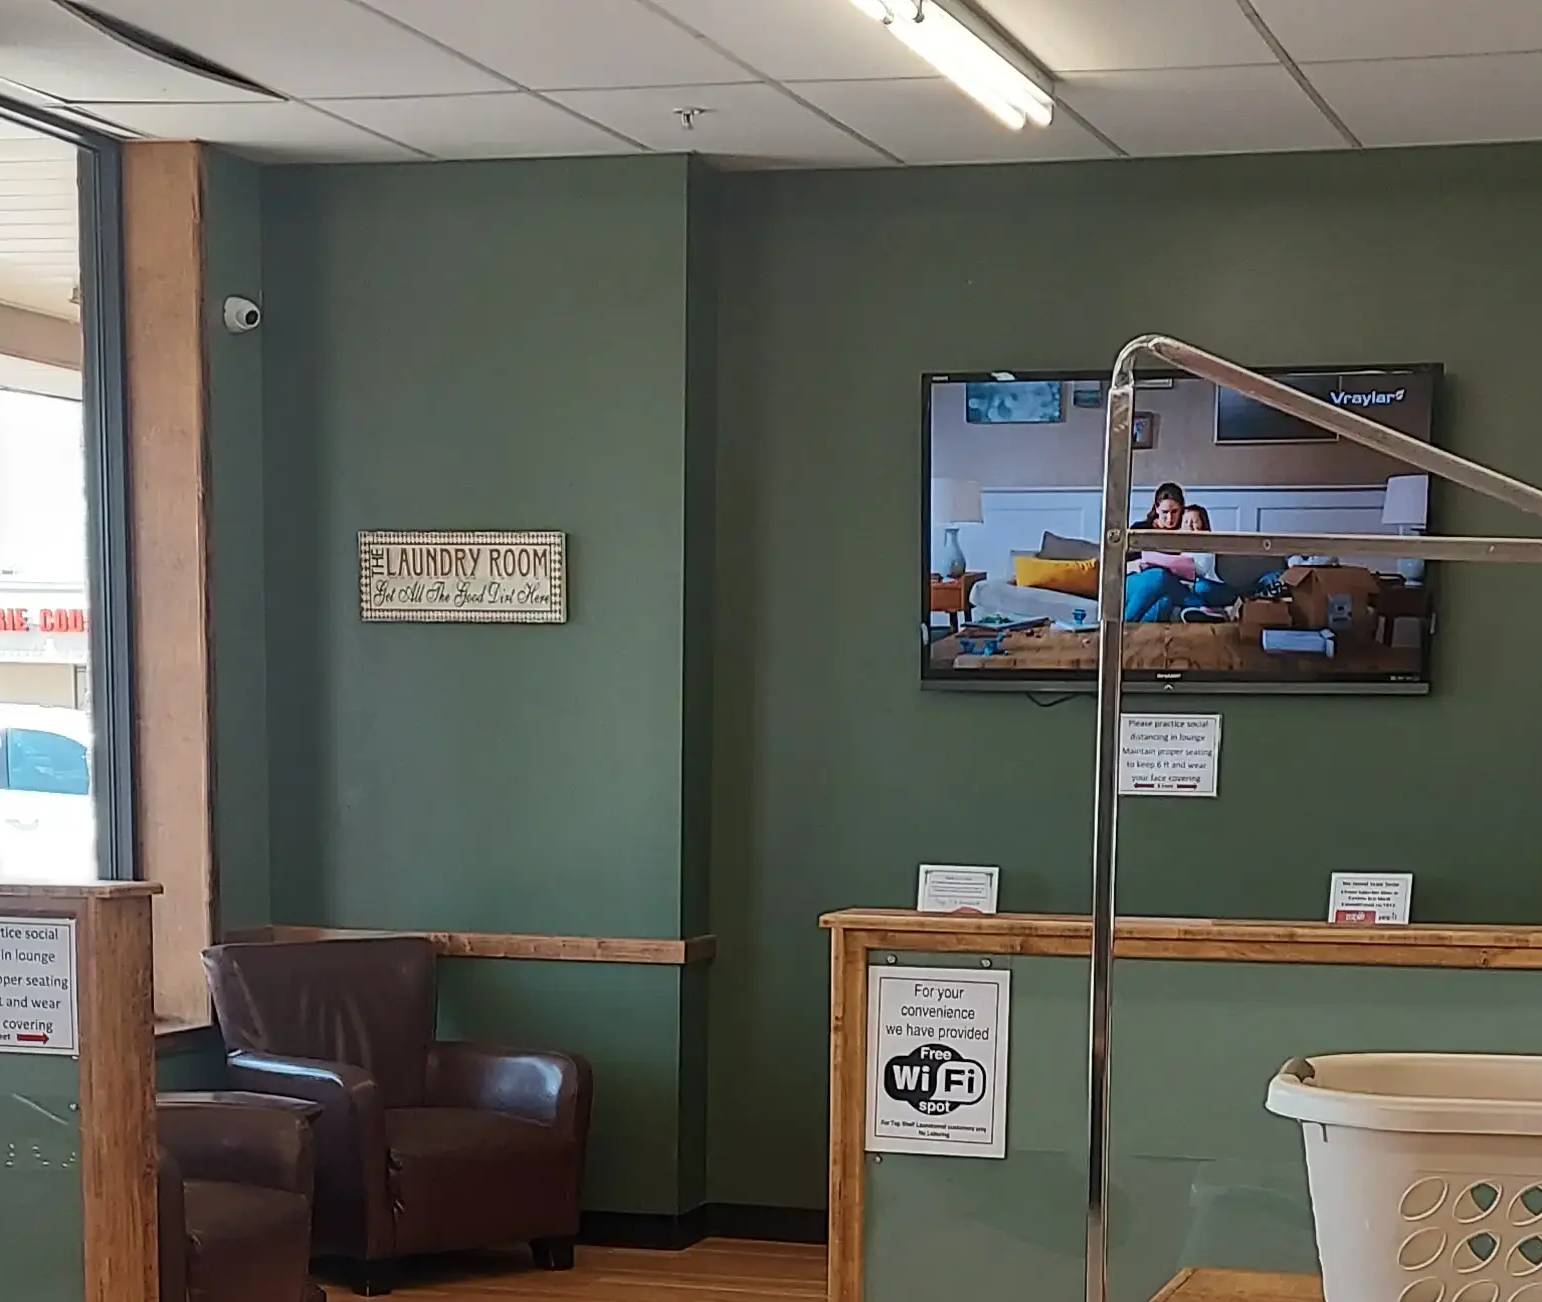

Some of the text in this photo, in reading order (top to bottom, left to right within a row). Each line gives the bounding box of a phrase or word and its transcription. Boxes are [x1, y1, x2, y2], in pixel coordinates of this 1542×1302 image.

[1330, 391, 1396, 407] Vraylar
[371, 547, 548, 577] THE LAUNDRY ROOM
[373, 579, 549, 608] Get All The Good Dirt Here
[1154, 720, 1185, 728] practice
[1187, 720, 1208, 728] social
[1130, 733, 1169, 742] distancing
[1179, 733, 1206, 742] lounge
[1137, 761, 1155, 769] keep
[1172, 761, 1186, 769] and
[1151, 774, 1166, 782] face
[1168, 775, 1201, 783] covering
[25, 928, 58, 940] social
[1, 950, 12, 960] in
[15, 949, 55, 964] lounge
[26, 977, 68, 990] seating
[914, 983, 964, 1001] For your
[6, 996, 27, 1008] and
[31, 999, 61, 1009] wear
[901, 1005, 975, 1020] convenience
[3, 1019, 53, 1034] covering
[886, 1023, 989, 1041] we have provided
[920, 1047, 952, 1061] Free
[892, 1065, 975, 1094] Wi Fi
[919, 1101, 951, 1113] spot
